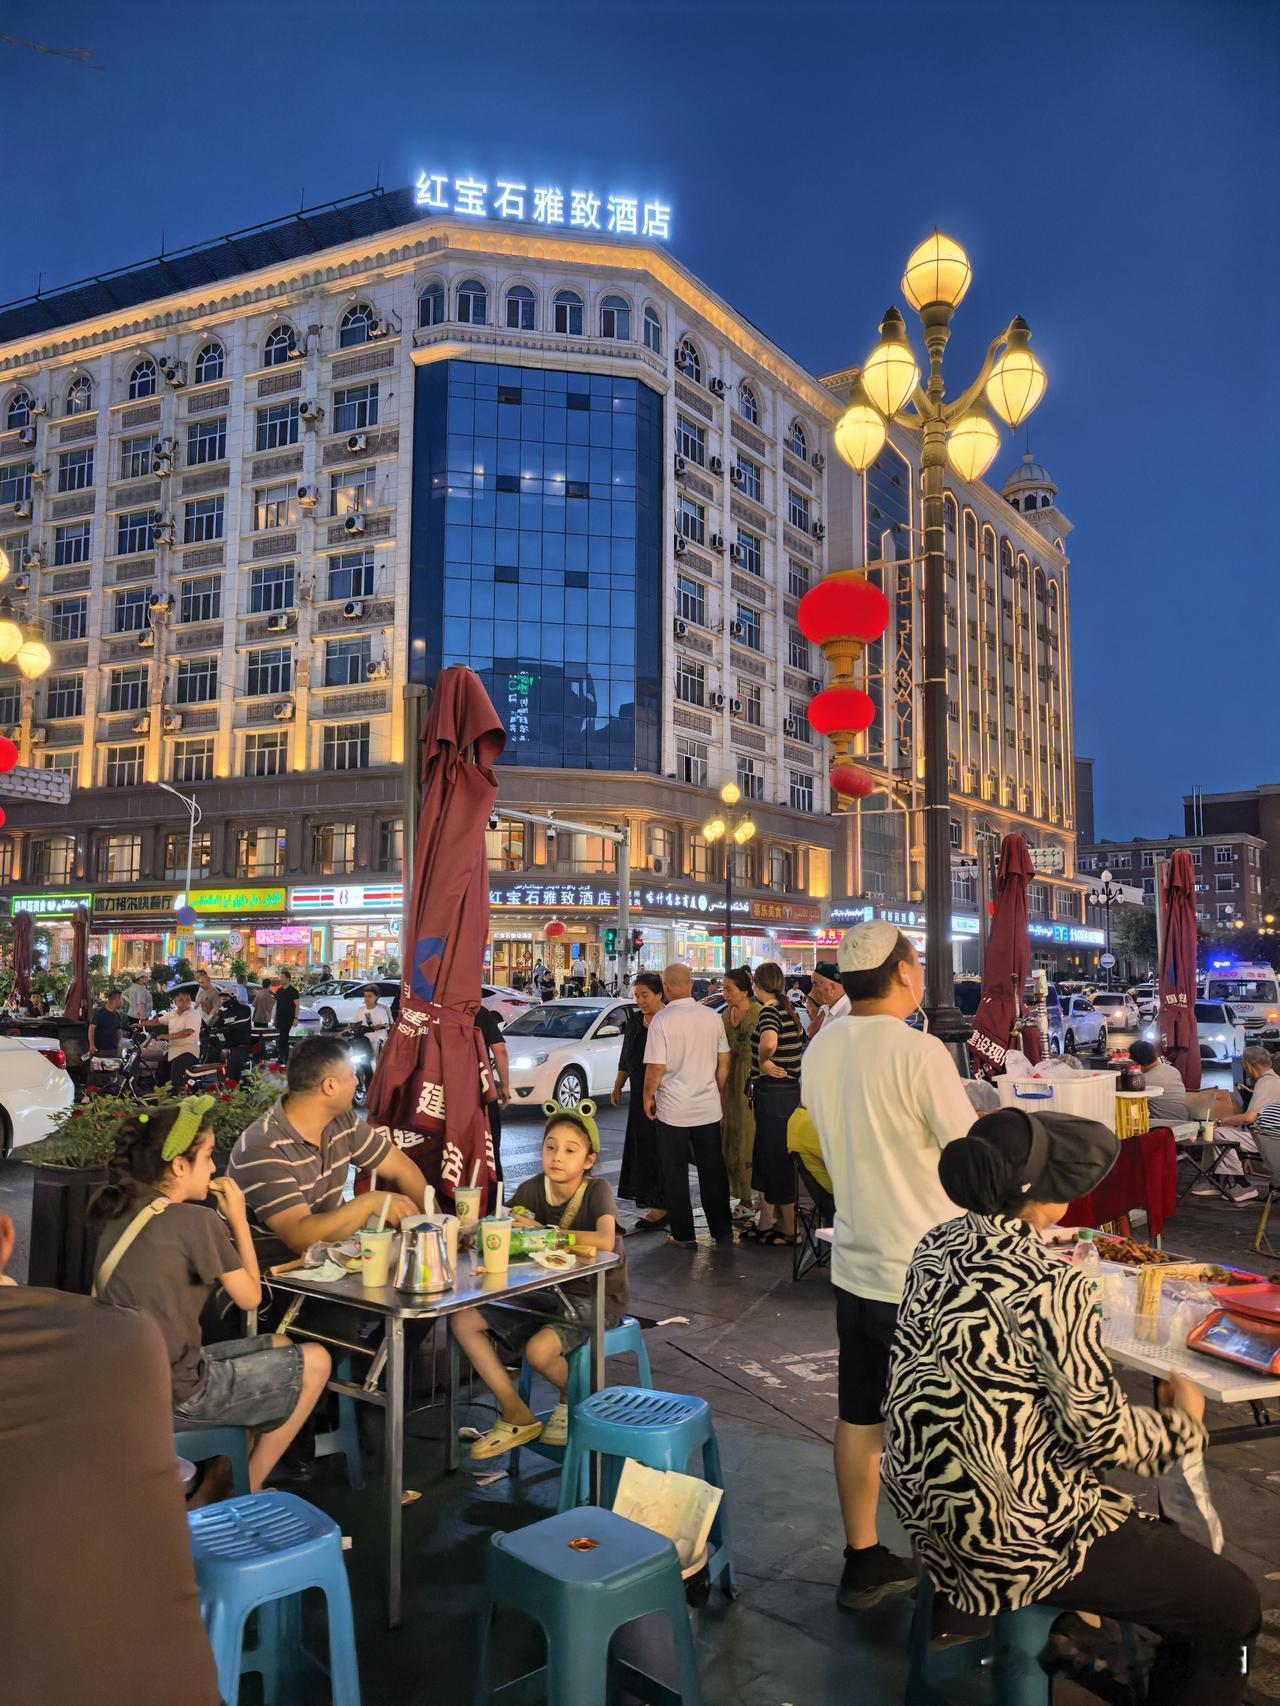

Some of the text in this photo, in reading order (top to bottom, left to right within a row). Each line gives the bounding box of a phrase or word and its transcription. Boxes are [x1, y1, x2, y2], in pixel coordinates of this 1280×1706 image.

[416, 171, 671, 239] 红宝石雅致酒店
[489, 890, 611, 906] 红宝石雅致酒店
[230, 935, 240, 945] 30
